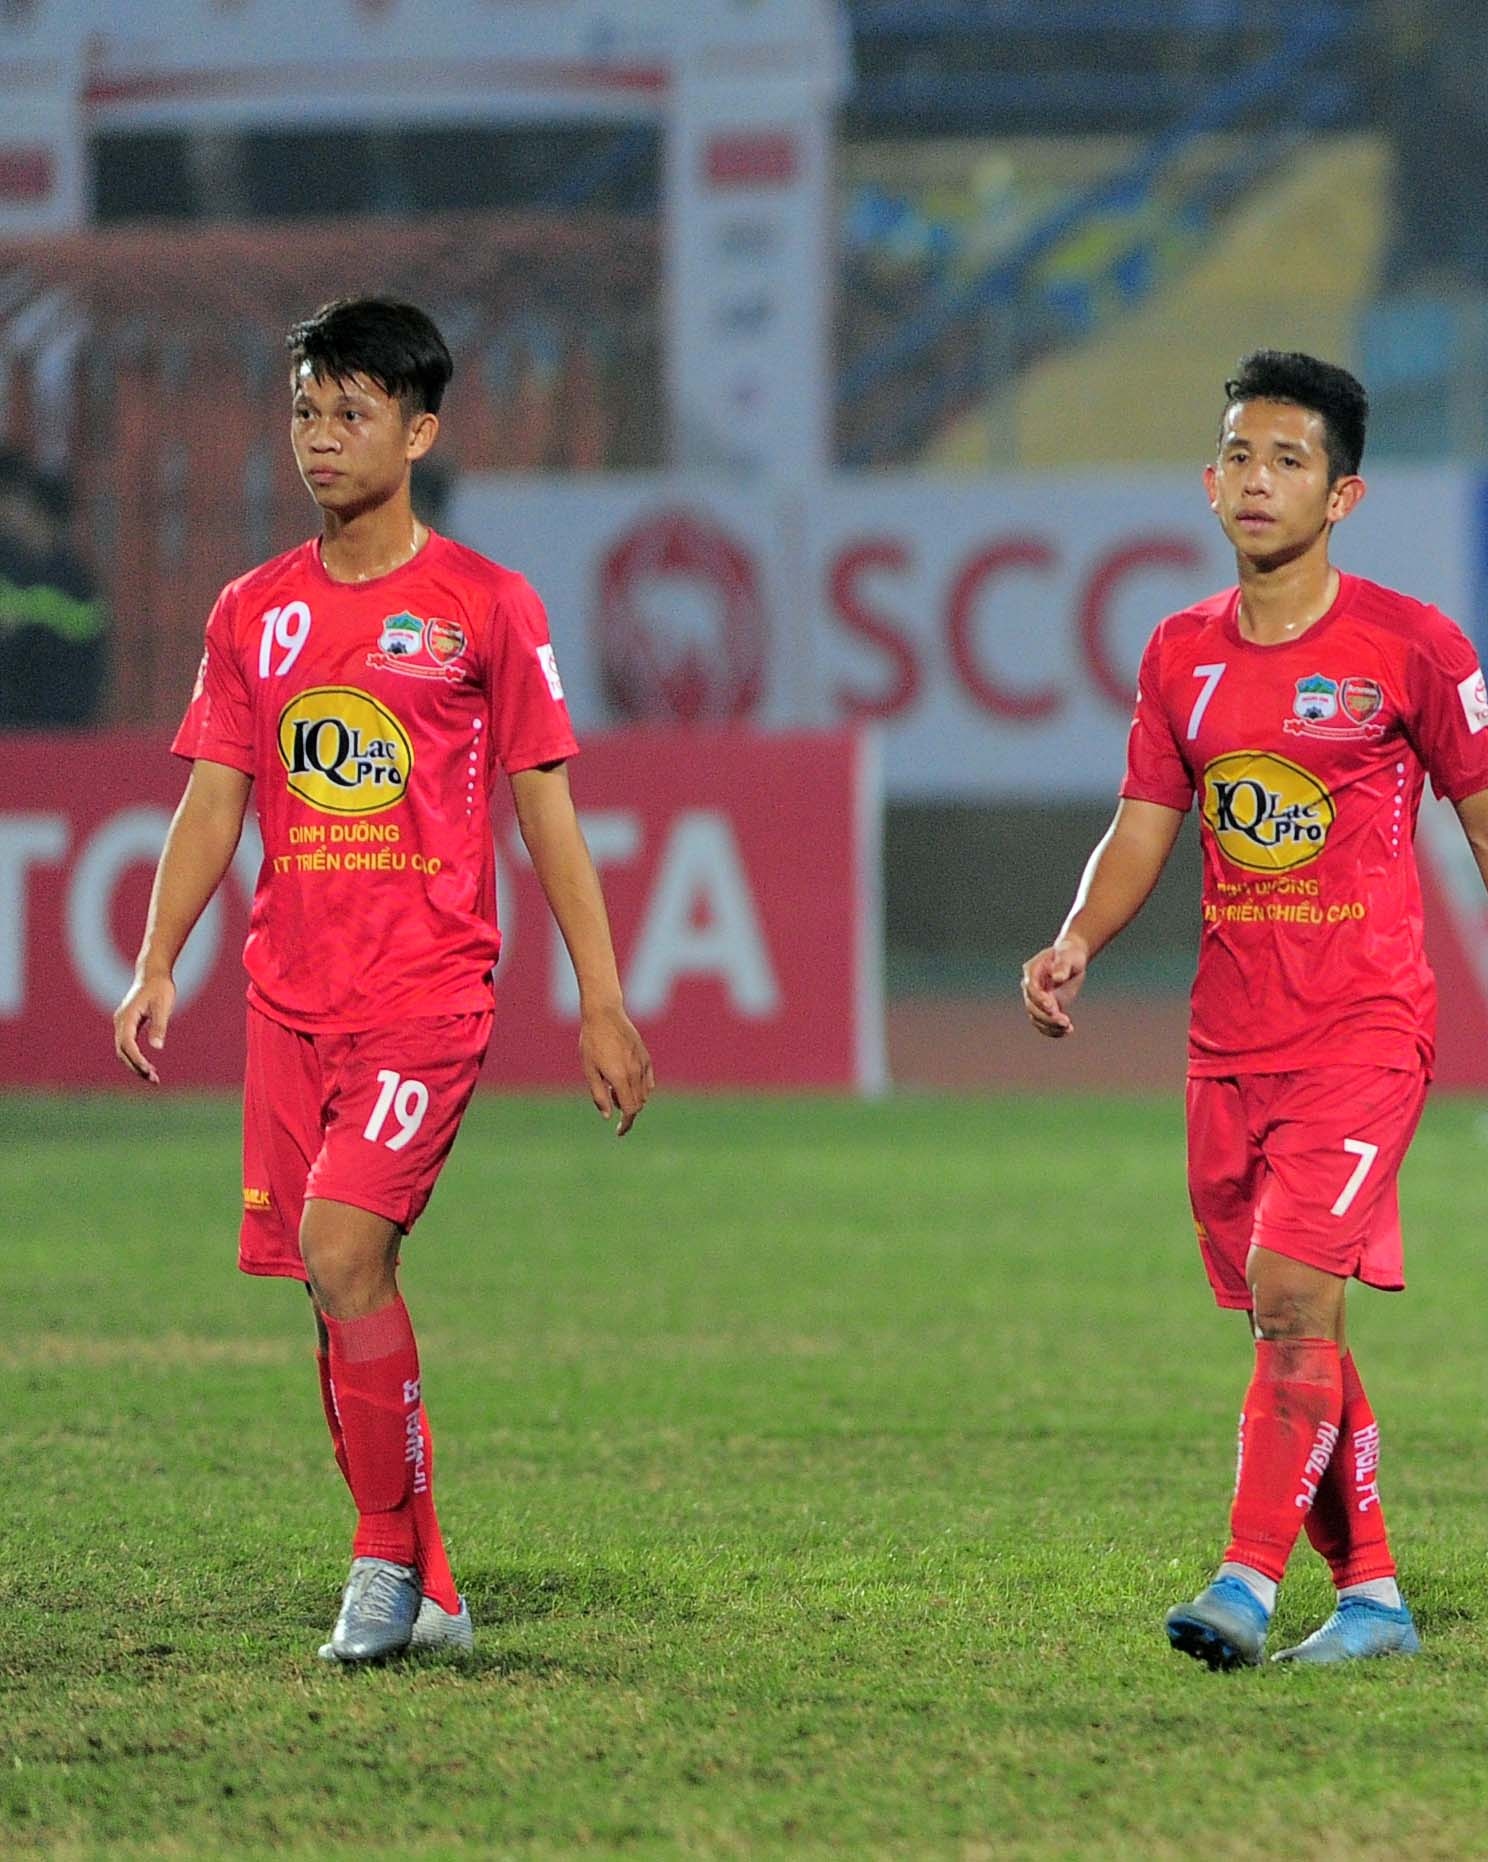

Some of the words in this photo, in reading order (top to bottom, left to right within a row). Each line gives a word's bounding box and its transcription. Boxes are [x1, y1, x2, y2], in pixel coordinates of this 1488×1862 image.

[258, 600, 312, 679] 19
[822, 532, 1206, 724] SCC
[1186, 662, 1227, 740] 7
[289, 718, 357, 787] IQ
[350, 729, 396, 760] Lac
[357, 761, 402, 784] Pro
[289, 824, 325, 844] DINH
[1212, 780, 1280, 846] IQ
[1275, 821, 1322, 843] Pro
[1326, 902, 1366, 922] CAO
[363, 1069, 429, 1151] 19
[1329, 1137, 1379, 1217] 7
[1304, 1420, 1340, 1477] HAGL
[1352, 1423, 1381, 1483] HAGL
[1294, 1477, 1318, 1508] FC
[1356, 1479, 1381, 1513] FC
